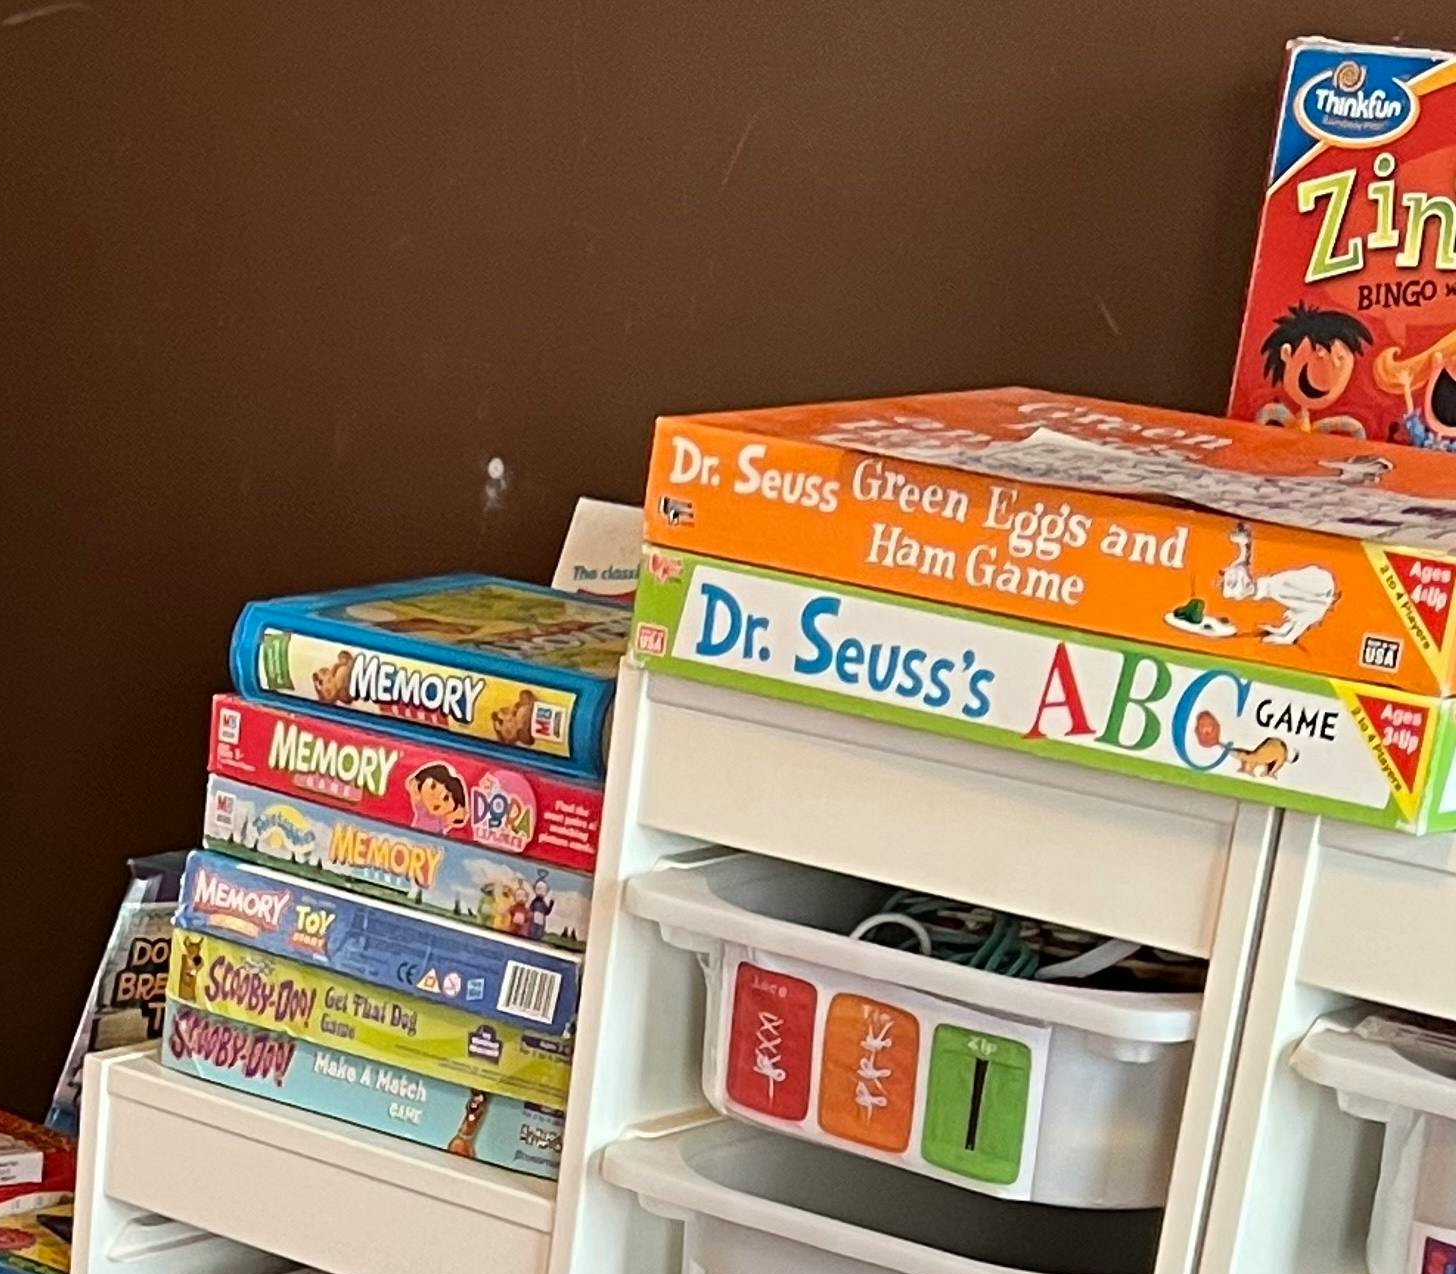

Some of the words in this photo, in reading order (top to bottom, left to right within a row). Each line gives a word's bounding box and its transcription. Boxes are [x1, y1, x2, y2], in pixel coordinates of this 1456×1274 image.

[1358, 280, 1437, 310] BINGO
[670, 436, 720, 487] Dr.
[734, 443, 839, 512] Seuss
[853, 458, 968, 523] Green
[982, 485, 1092, 560] Eggs
[1100, 523, 1190, 569] and
[574, 565, 598, 581] The
[866, 522, 957, 579] Ham
[965, 545, 1084, 605] Game
[1409, 561, 1452, 584] Ages
[1401, 600, 1431, 650] Players
[695, 582, 771, 662] Dr.
[794, 596, 995, 718] Seuss's
[1023, 641, 1252, 772] ABC
[1256, 699, 1339, 741] GAME
[1364, 645, 1395, 667] USA
[349, 653, 486, 723] MEMORY
[1380, 704, 1423, 727] Ages
[267, 719, 399, 796] MEMORY
[1372, 743, 1403, 793] Players
[473, 789, 531, 839] DORA
[329, 821, 442, 889] MEMORY
[193, 868, 291, 926] MEMORY
[296, 904, 336, 935] TOY
[204, 955, 318, 1029] SCOOBY-DOO!
[323, 986, 348, 1014] Get
[352, 993, 386, 1025] That
[389, 1003, 419, 1036] Dog
[170, 1008, 298, 1088] SCOOBY-DOO!
[320, 1012, 355, 1040] Game
[314, 1051, 357, 1083] Make
[359, 1067, 372, 1085] A
[375, 1073, 427, 1102] Match
[388, 1102, 424, 1125] GAME
